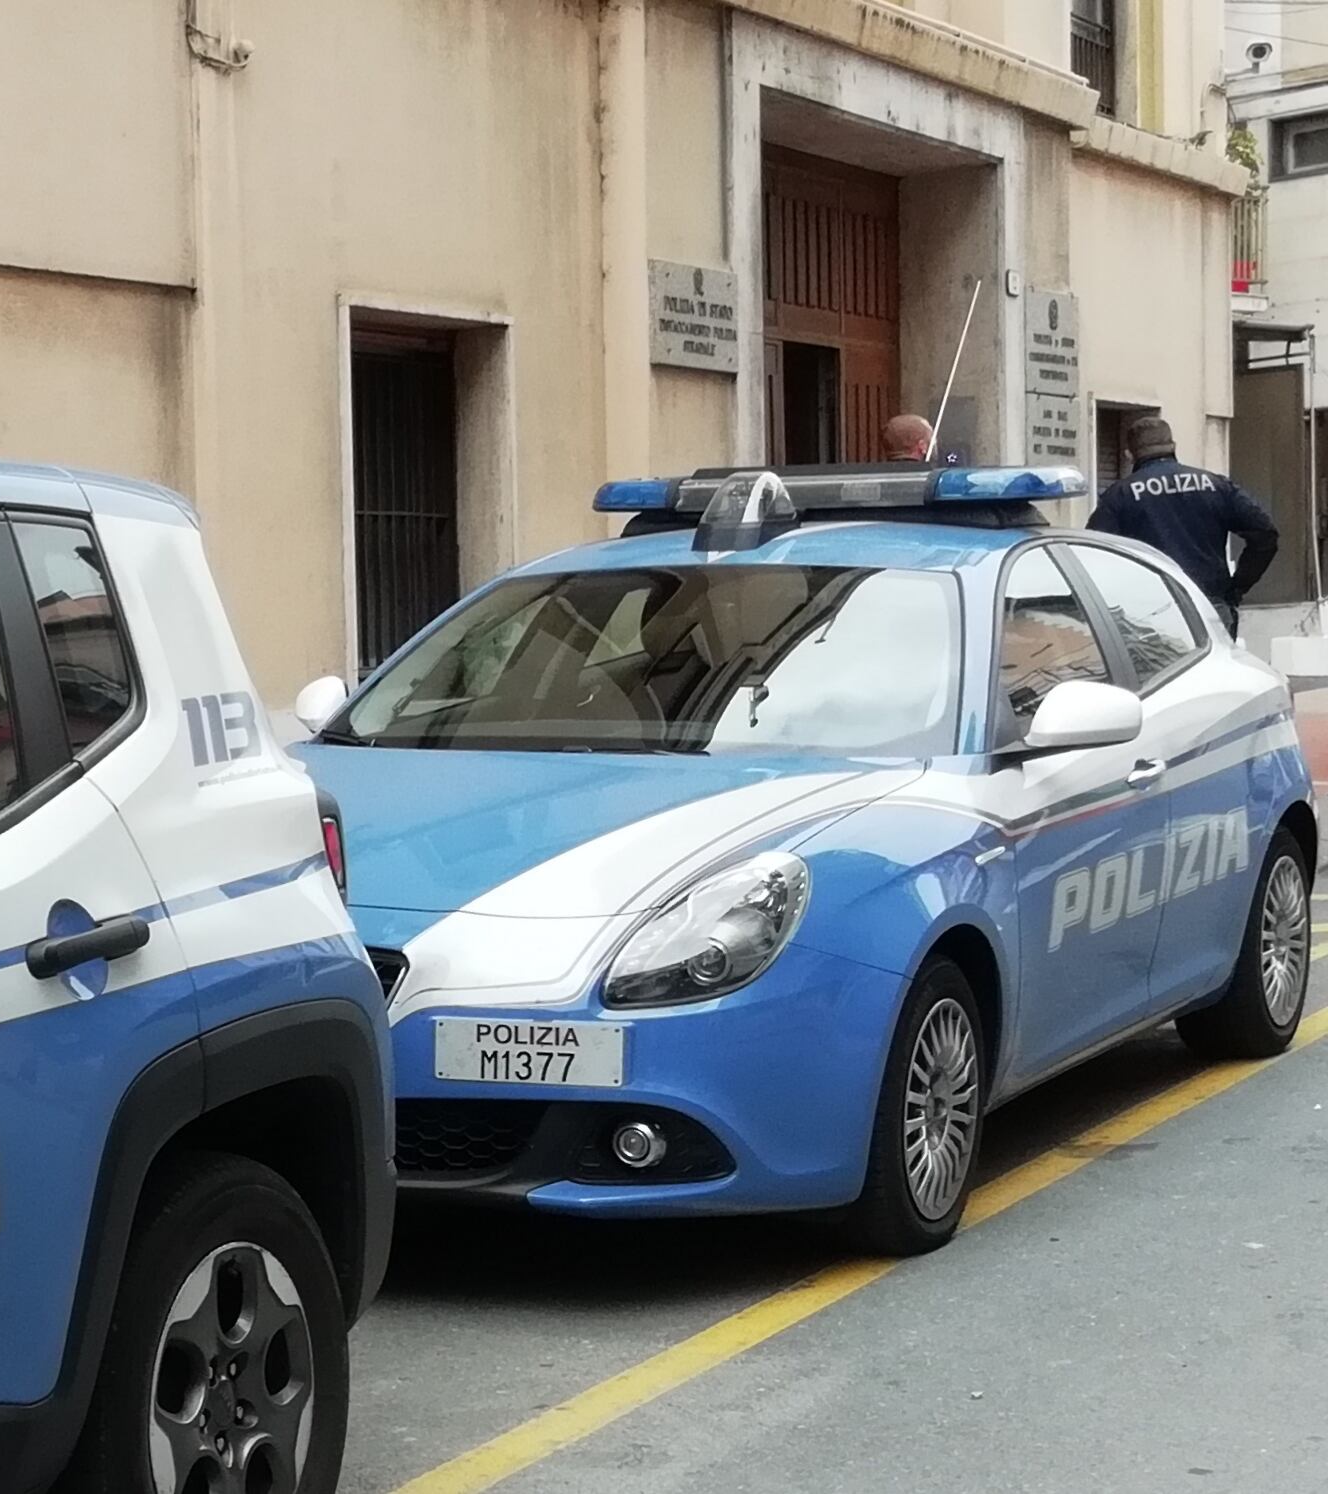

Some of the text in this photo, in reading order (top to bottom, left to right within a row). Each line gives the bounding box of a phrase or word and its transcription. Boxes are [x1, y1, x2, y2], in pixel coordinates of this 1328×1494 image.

[1130, 473, 1216, 500] POLIZIA
[181, 691, 262, 767] 113
[1047, 805, 1250, 953] POLIZIA
[476, 1023, 580, 1047] POLIZIA
[480, 1050, 575, 1082] M1377
